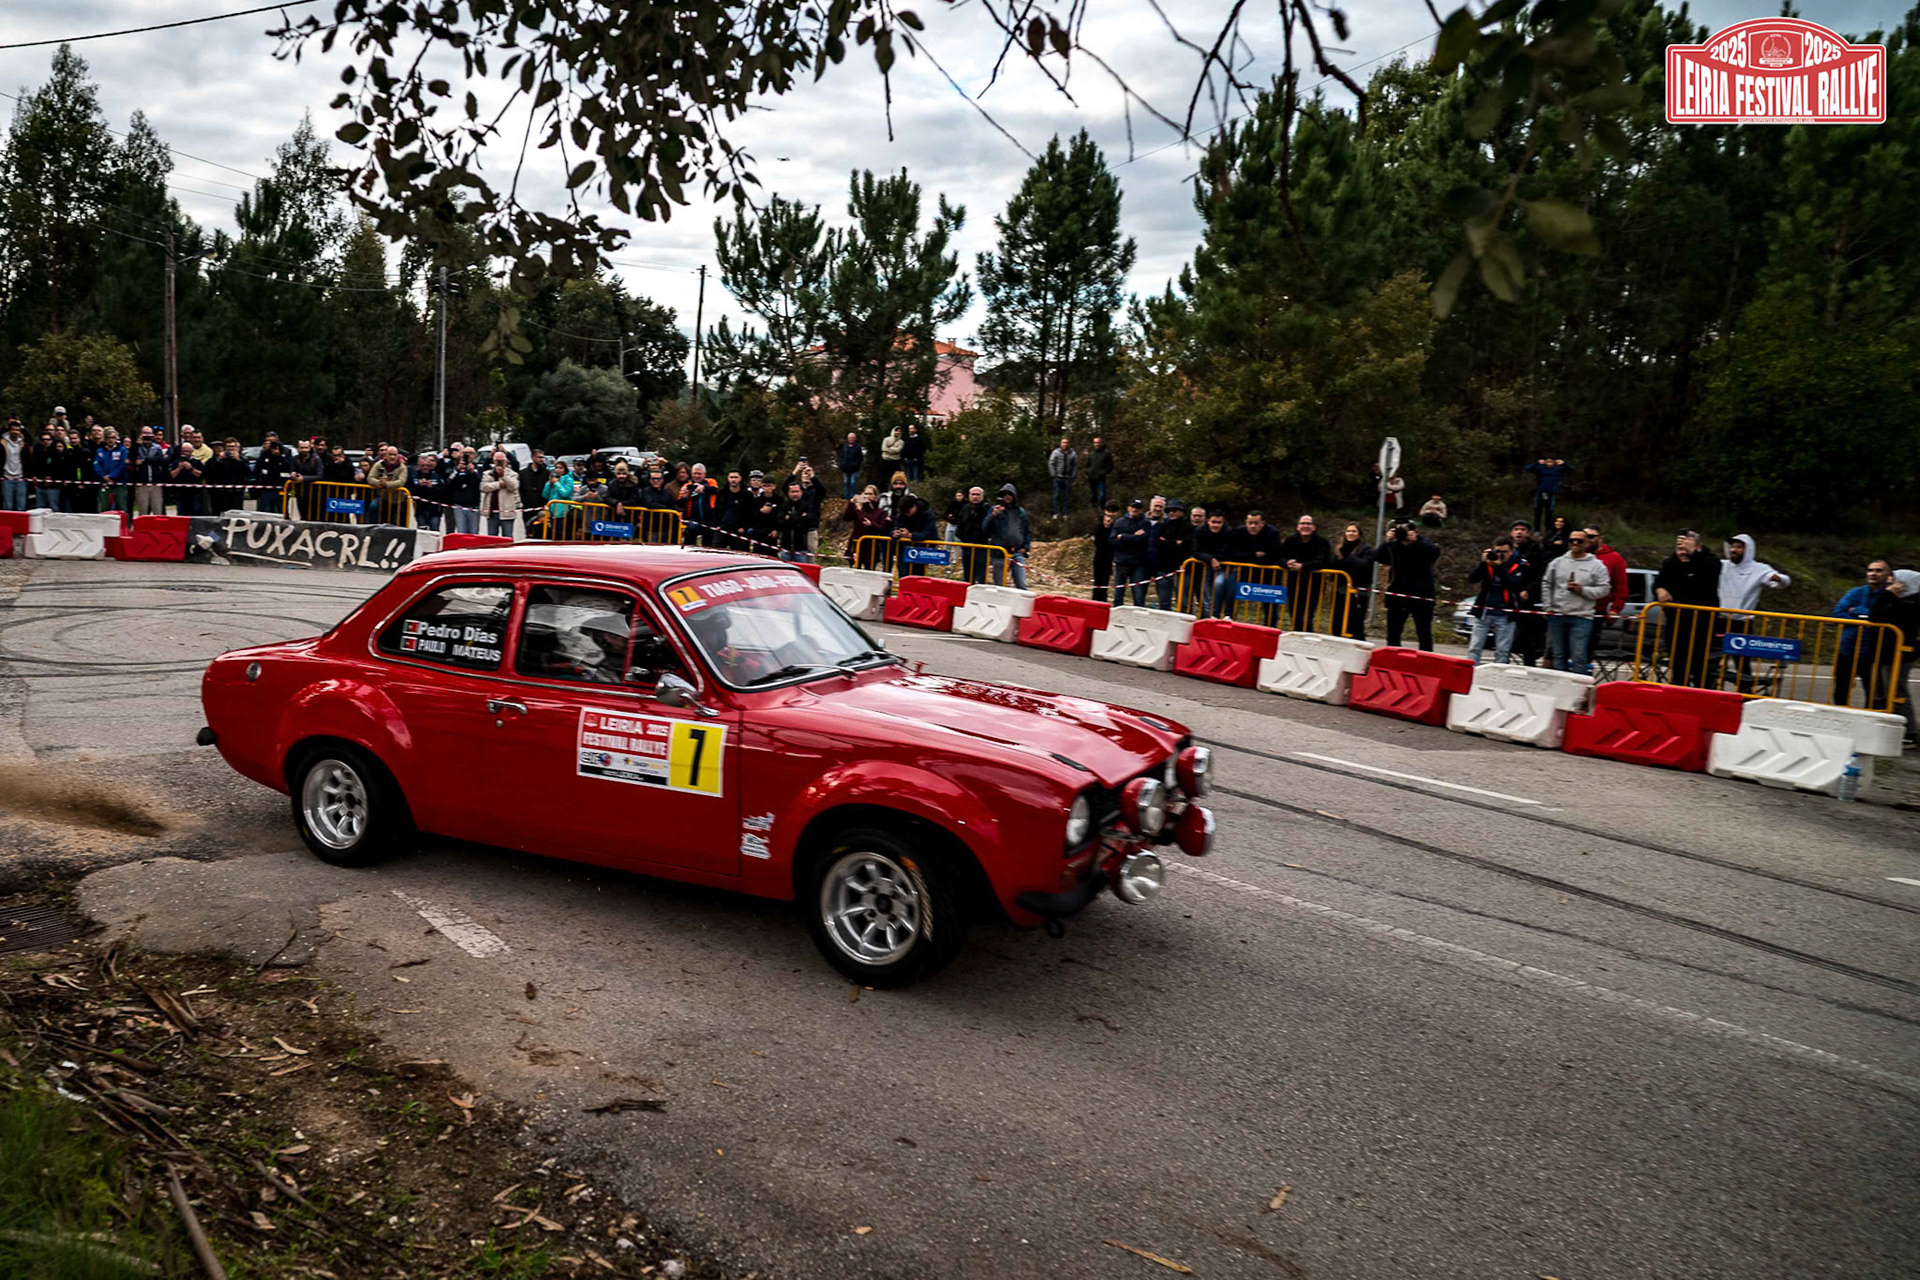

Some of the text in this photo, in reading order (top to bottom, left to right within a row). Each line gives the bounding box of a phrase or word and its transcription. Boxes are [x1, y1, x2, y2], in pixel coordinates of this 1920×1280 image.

[222, 517, 406, 569] PUXACRL!!
[676, 590, 692, 603] 1
[418, 622, 498, 644] Pedro Dias
[418, 639, 502, 661] PAULO MATEUS
[600, 716, 644, 735] LEIRIA
[583, 732, 668, 756] FESTIVAL RALLYE
[688, 728, 707, 786] 1
